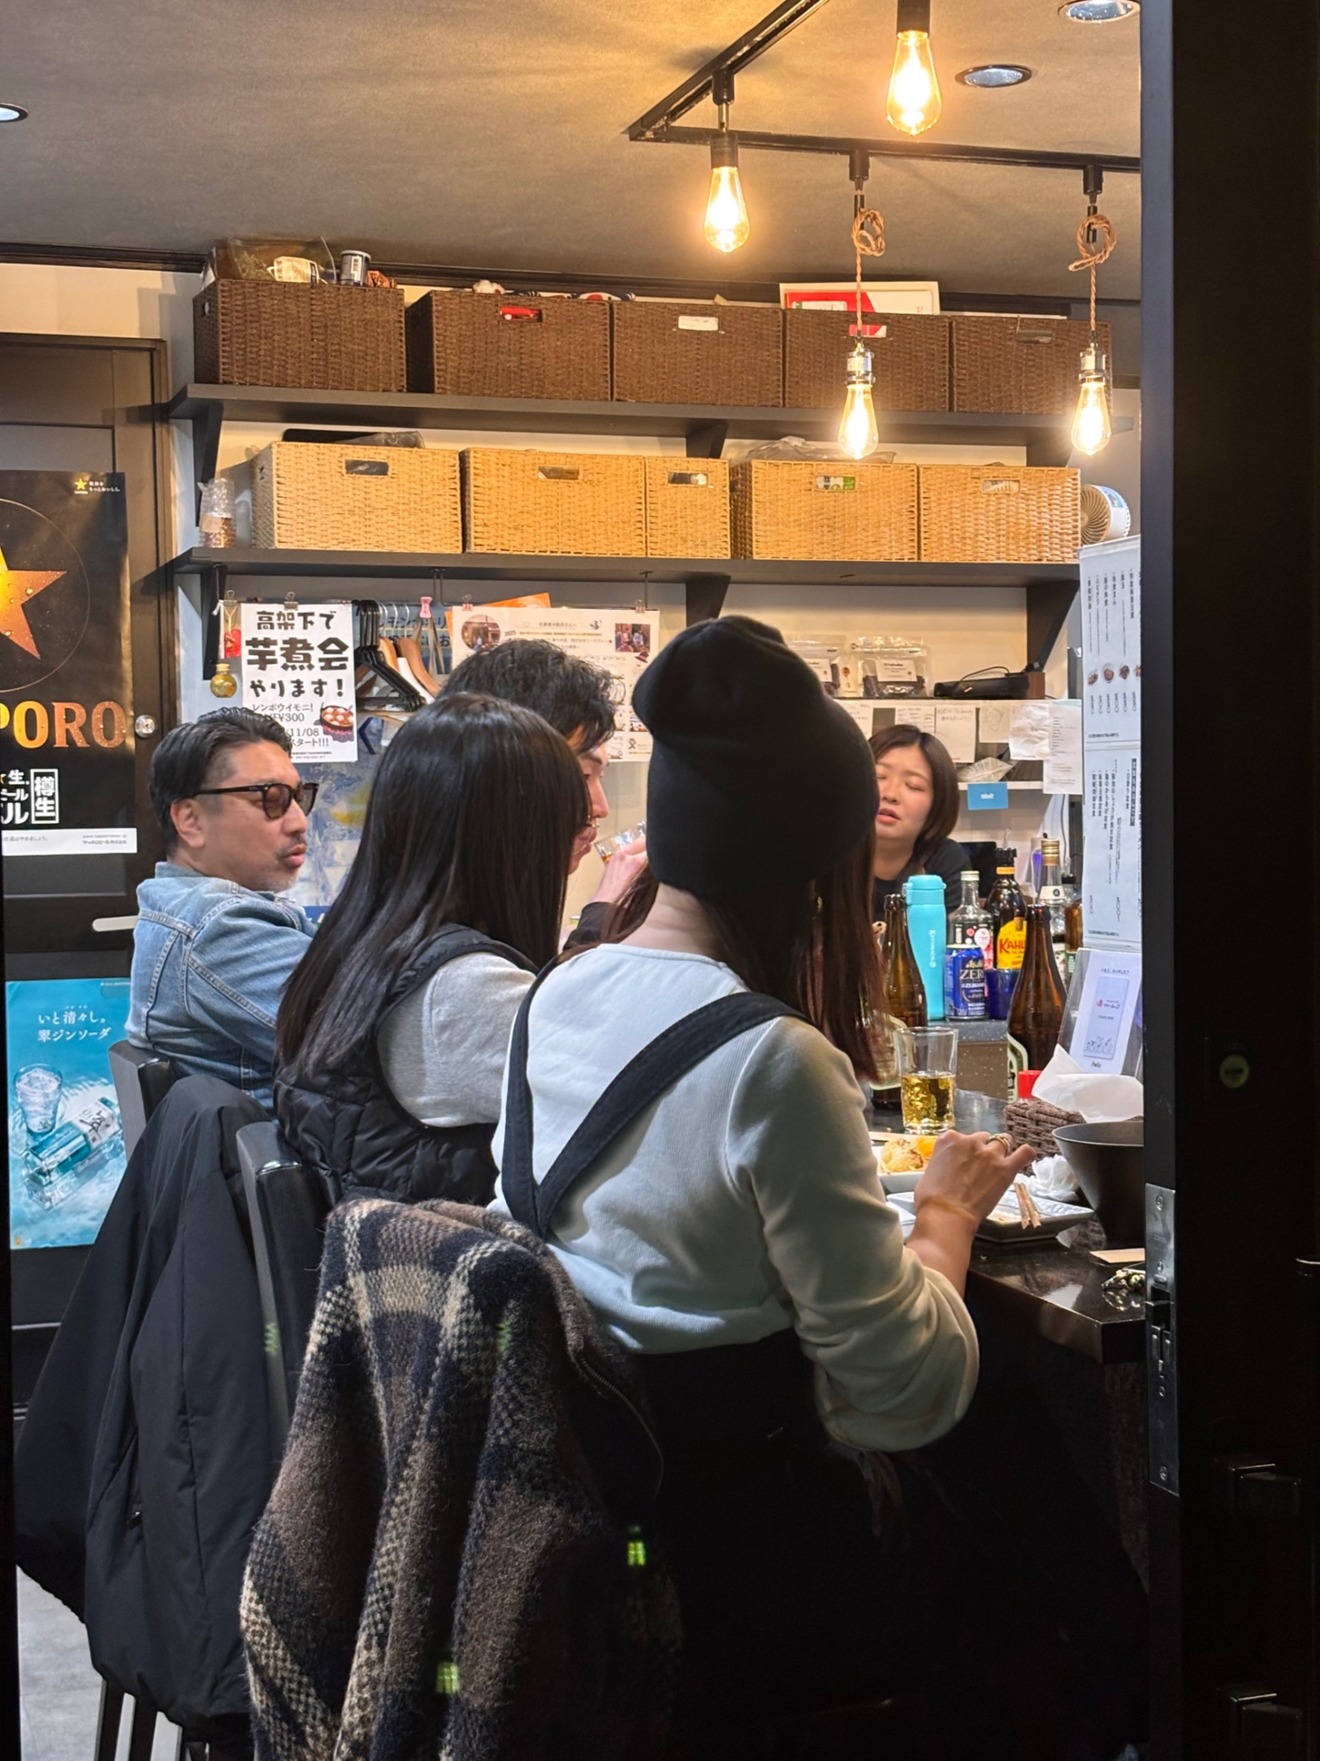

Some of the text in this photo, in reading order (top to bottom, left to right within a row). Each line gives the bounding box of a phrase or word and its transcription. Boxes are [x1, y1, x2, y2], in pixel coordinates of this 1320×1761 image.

[256, 610, 337, 631] 高架下で
[245, 637, 349, 672] 芋煮会
[249, 678, 345, 698] やります！
[0, 700, 126, 749] ORO
[34, 776, 56, 817] 樽生
[1, 802, 30, 825] ル
[999, 938, 1025, 954] KAHL
[959, 969, 984, 980] ZER
[37, 1027, 112, 1043] 翠ジンソーダ
